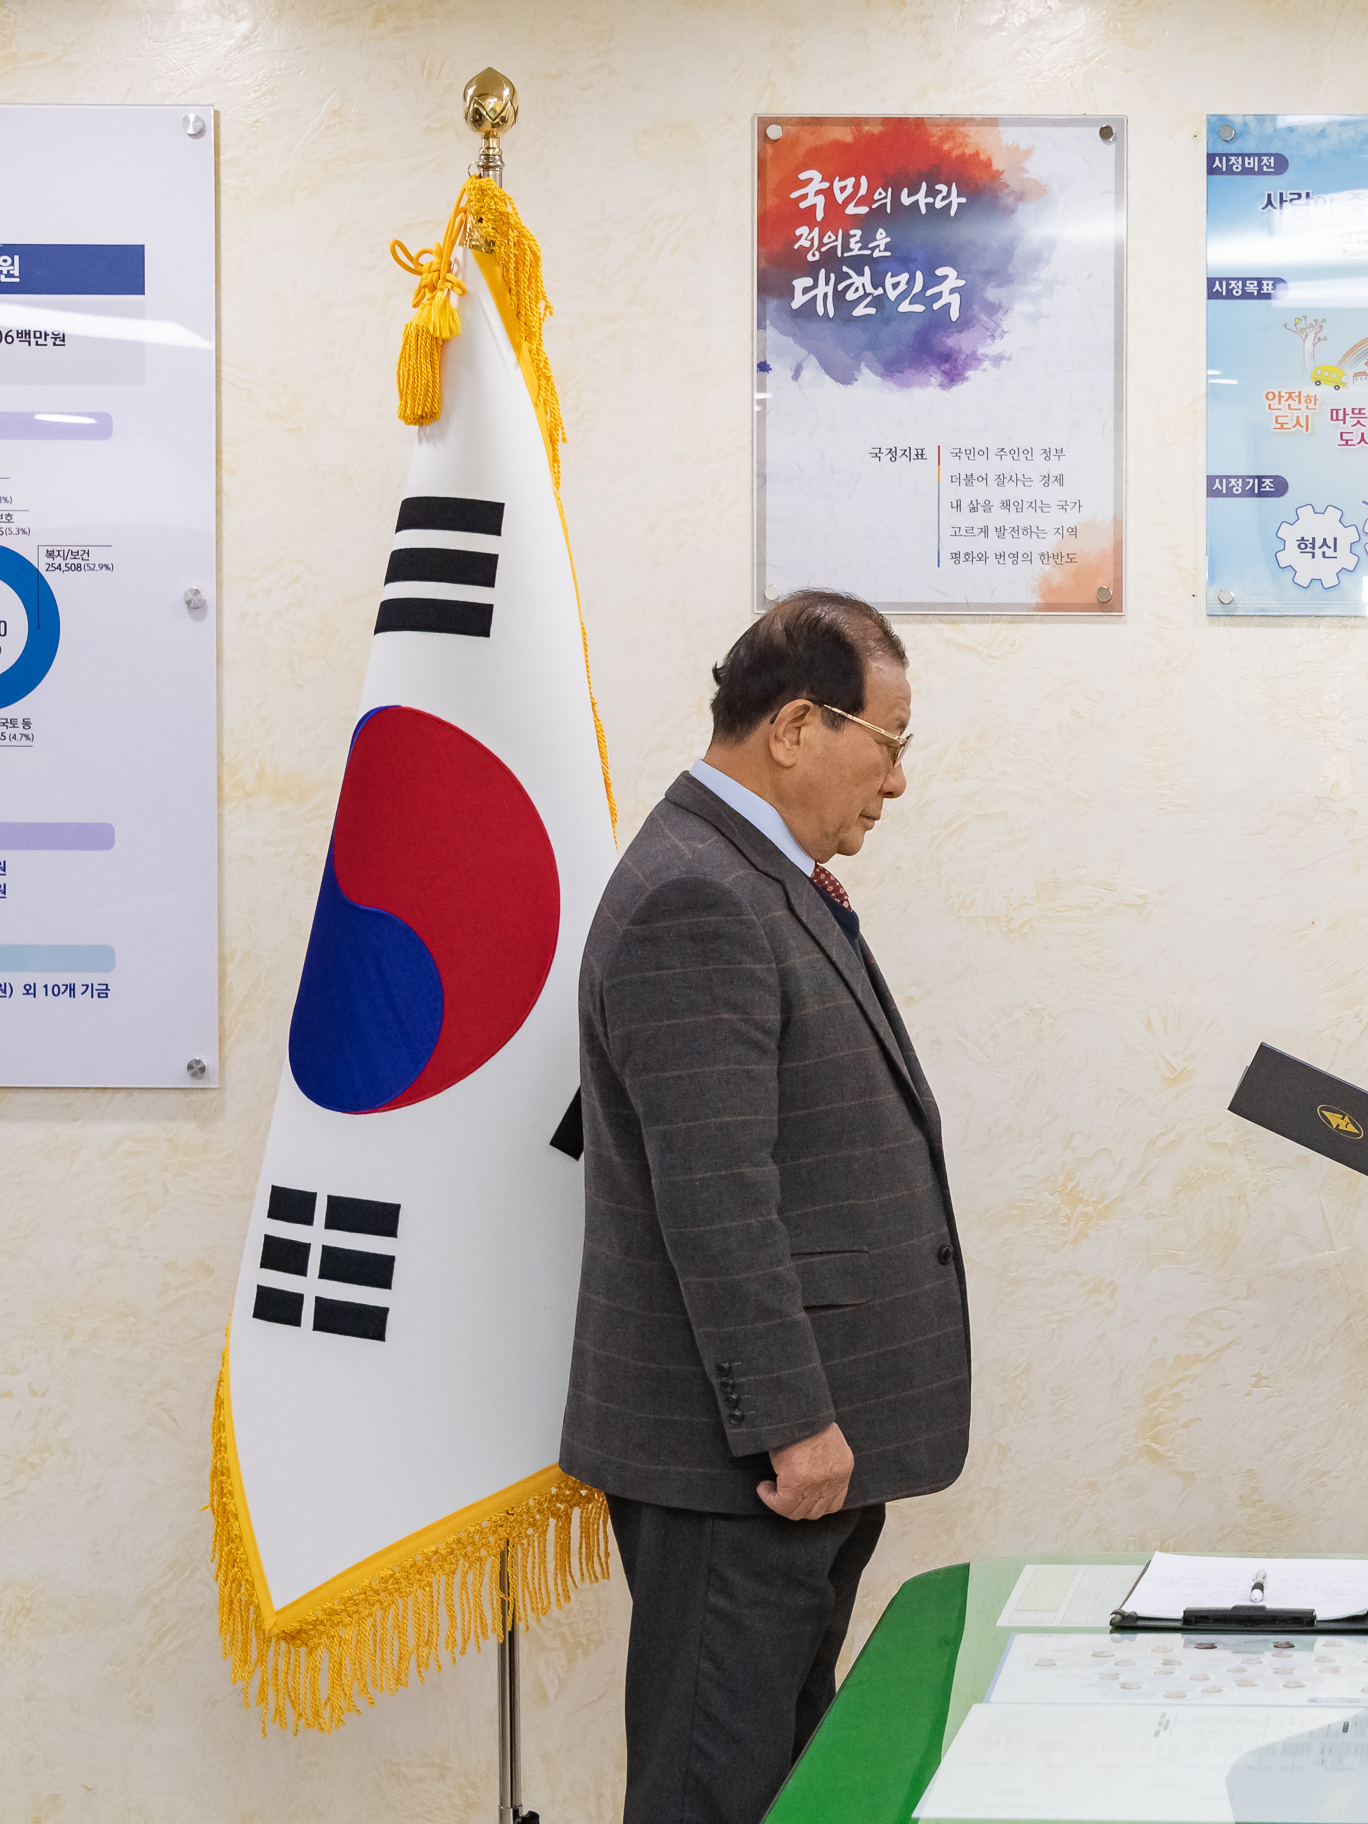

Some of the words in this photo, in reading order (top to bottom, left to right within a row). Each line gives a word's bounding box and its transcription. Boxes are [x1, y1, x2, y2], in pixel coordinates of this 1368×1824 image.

[1212, 156, 1276, 172] 시정비전
[790, 169, 892, 222] 국민의
[900, 181, 967, 216] 나라
[794, 226, 891, 262] 정의로운
[791, 266, 966, 322] 대한민국
[1212, 280, 1276, 296] 시정목표
[1264, 391, 1319, 411] 안전한
[1272, 414, 1310, 433] 도시
[869, 446, 927, 463] 국정지표
[950, 447, 989, 461] 국민이
[994, 447, 1034, 461] 주인인
[1040, 447, 1066, 461] 정부
[950, 473, 989, 487] 더불어
[993, 473, 1033, 487] 잘사는
[1039, 473, 1064, 487] 경제
[1212, 478, 1276, 494] 시정기조
[950, 499, 962, 514] 내
[967, 499, 994, 514] 삶을
[999, 499, 1051, 514] 책임지는
[1057, 499, 1083, 514] 국가
[950, 525, 989, 540] 고르게
[994, 525, 1048, 540] 발전하는
[1053, 525, 1078, 540] 지역
[45, 549, 90, 561] 복지/보건
[1296, 537, 1338, 560] 혁신
[950, 551, 989, 566] 평화와
[994, 551, 1033, 566] 번영의
[1038, 551, 1078, 566] 한반도
[22, 718, 32, 730] 등
[22, 983, 36, 998] 외
[43, 983, 76, 998] 10개
[81, 983, 111, 998] 기금
